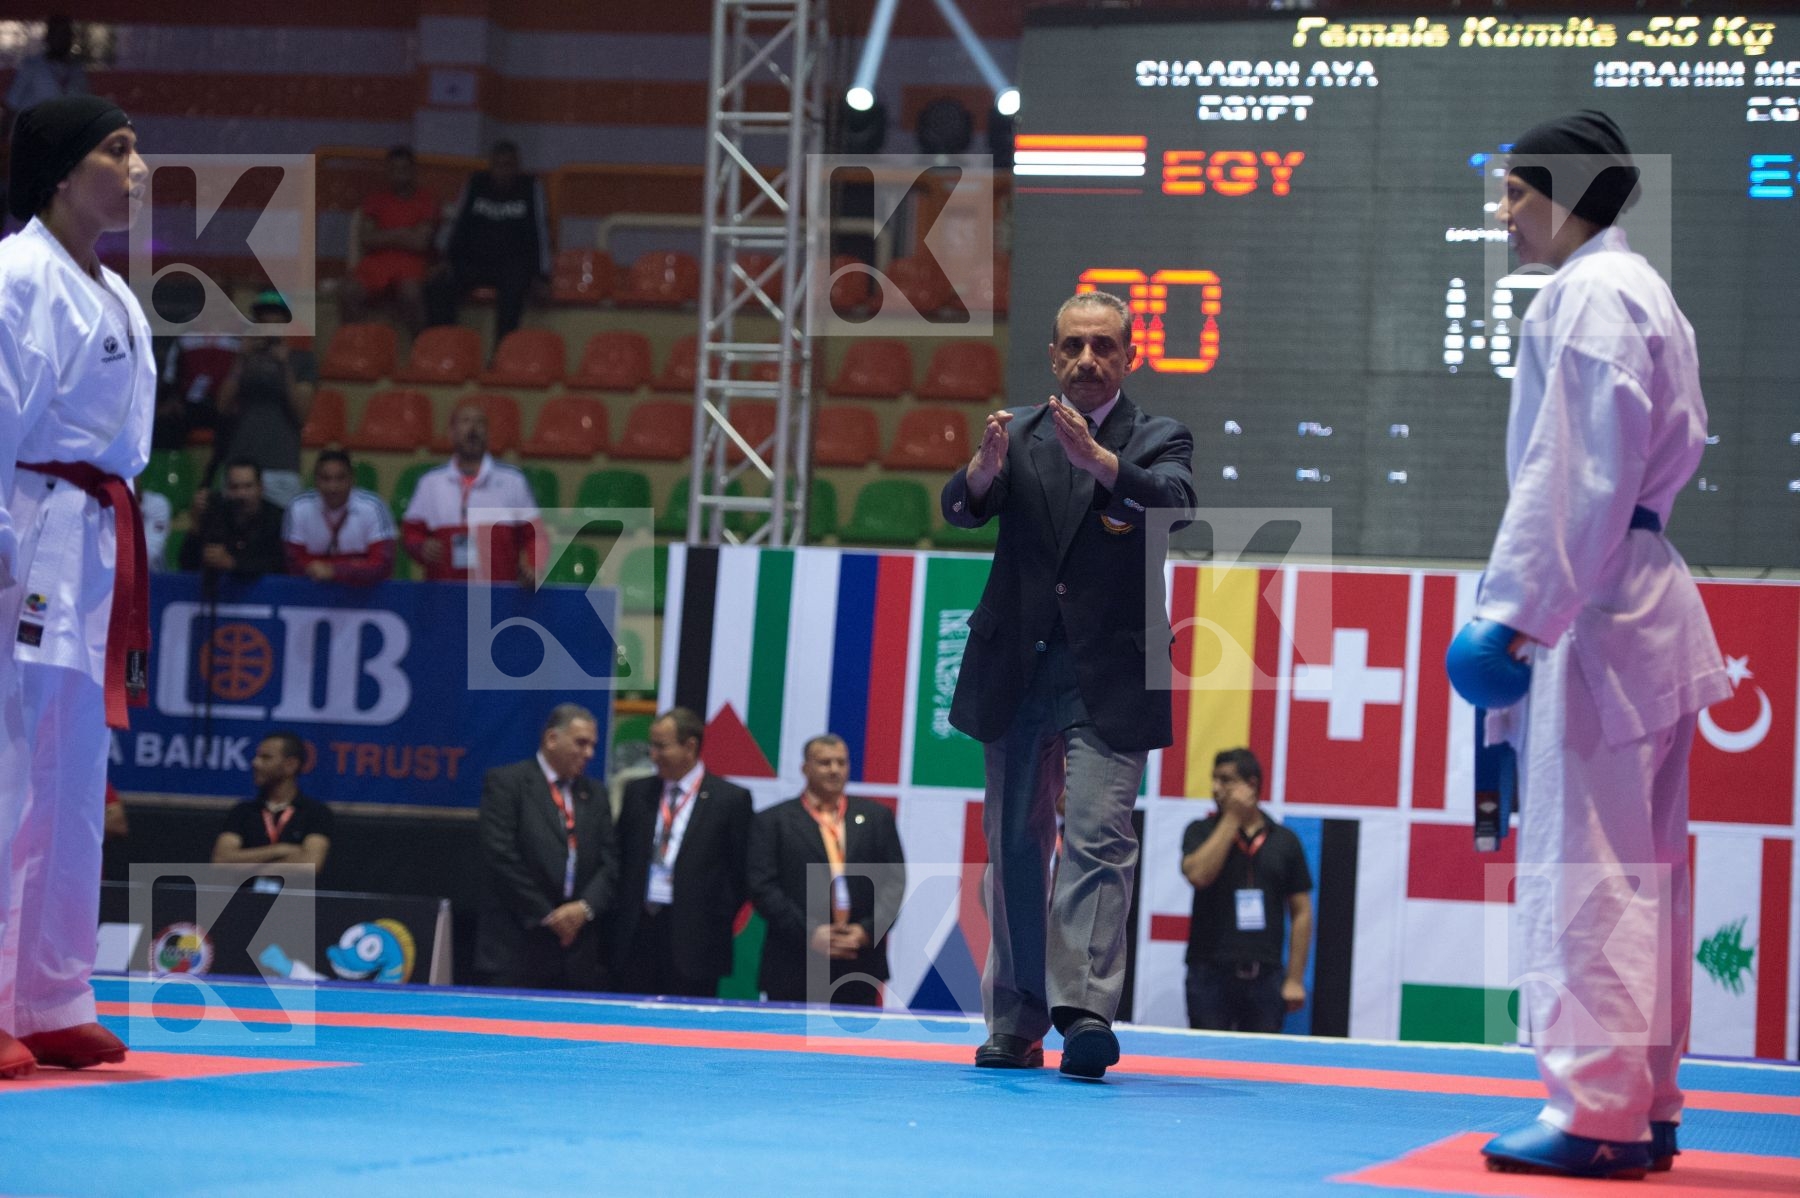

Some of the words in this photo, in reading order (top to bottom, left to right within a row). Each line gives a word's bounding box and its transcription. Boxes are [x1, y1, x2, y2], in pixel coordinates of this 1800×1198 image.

[1306, 60, 1379, 87] AYA
[1198, 95, 1313, 121] EGYPT
[1162, 150, 1305, 195] EGY
[156, 601, 411, 726] CIB
[134, 731, 250, 771] BANK
[329, 741, 465, 780] TRUST
